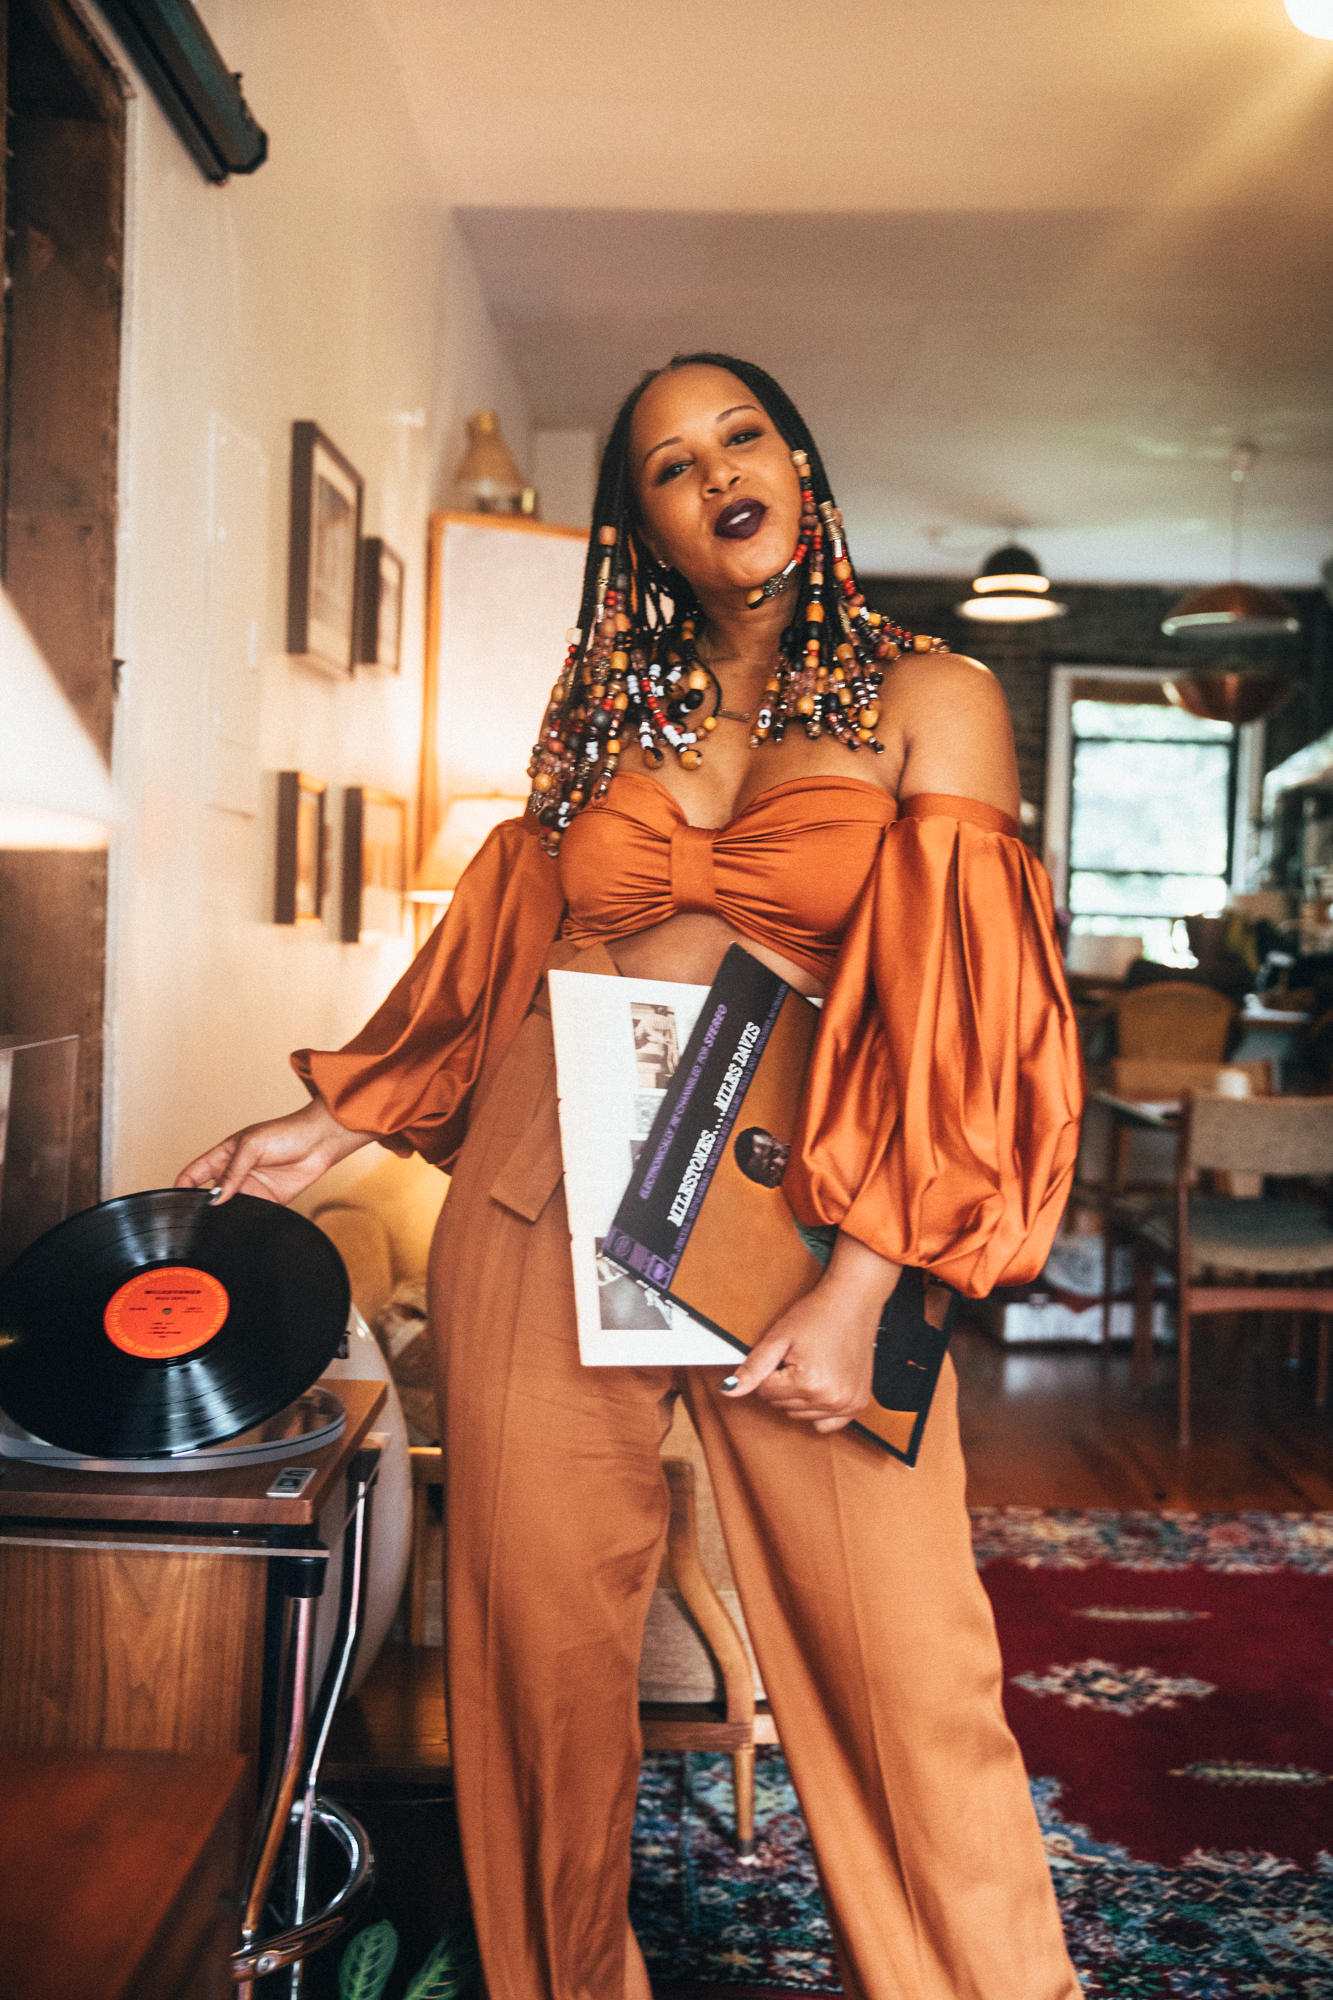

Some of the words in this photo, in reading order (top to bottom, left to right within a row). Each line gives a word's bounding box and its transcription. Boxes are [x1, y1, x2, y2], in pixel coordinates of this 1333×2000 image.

[696, 1046, 709, 1063] FOR
[703, 1003, 728, 1048] STEREO
[732, 1021, 761, 1067] DAVIS
